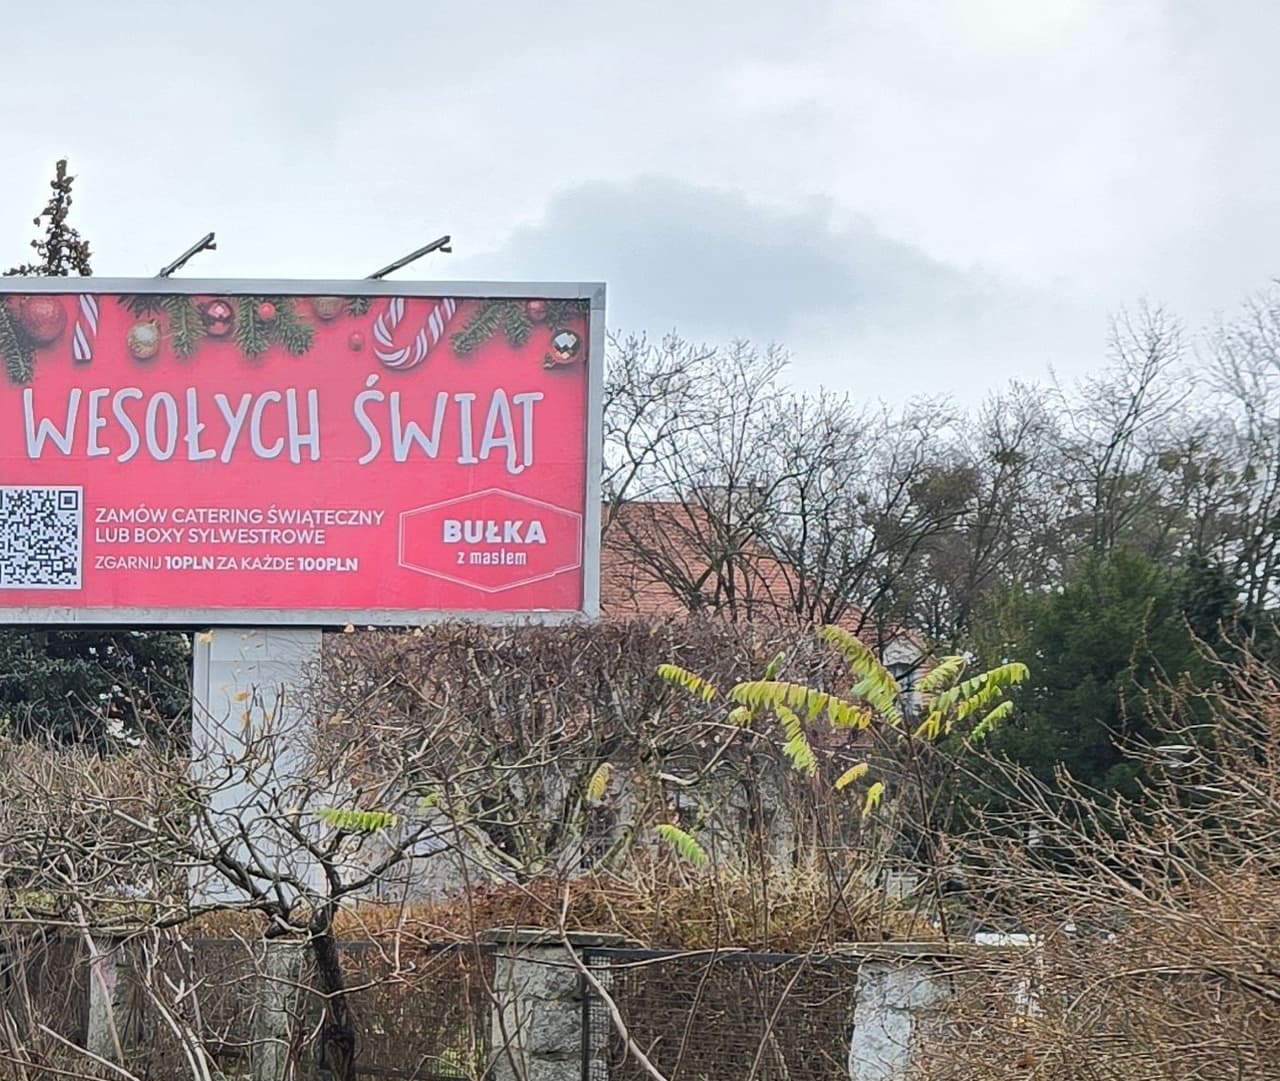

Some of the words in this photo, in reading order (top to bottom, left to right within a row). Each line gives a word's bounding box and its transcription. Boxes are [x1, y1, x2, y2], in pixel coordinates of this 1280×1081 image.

[23, 387, 320, 463] WESOŁYCH
[353, 374, 544, 474] ŚWIĄT
[95, 504, 167, 523] ZAMÓW
[172, 508, 263, 524] CATERING
[267, 504, 384, 528] ŚWIĄTECZNY
[95, 528, 130, 543] LUB
[134, 528, 184, 543] BOXY
[188, 529, 325, 544] SYLWESTROWE
[443, 519, 546, 544] BUŁKA
[95, 556, 161, 570] ZGARNIJ
[165, 556, 214, 570] 10PLN
[216, 557, 238, 570] ZA
[241, 554, 295, 570] KAŻDE
[297, 557, 358, 571] 100PLN
[457, 551, 465, 565] z
